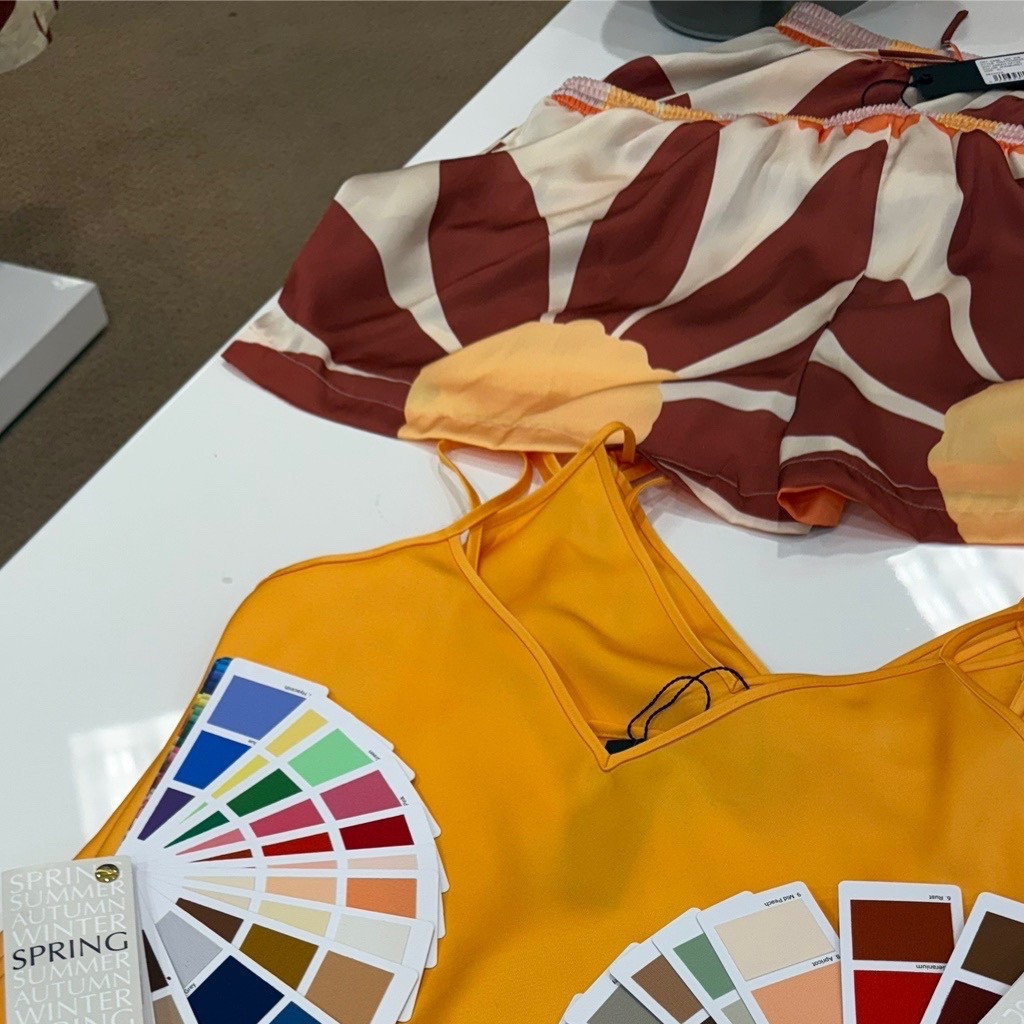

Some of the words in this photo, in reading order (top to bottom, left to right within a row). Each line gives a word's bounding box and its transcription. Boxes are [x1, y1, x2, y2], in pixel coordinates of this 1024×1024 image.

[9, 861, 123, 893] SPRIN
[10, 879, 124, 911] SUMMER
[764, 898, 783, 906] Peach
[11, 896, 125, 928] AUTUMN
[12, 912, 126, 946] WINTER
[12, 930, 128, 970] SPRING
[812, 956, 833, 966] Apricot
[13, 951, 130, 989] SUMMER
[13, 970, 131, 1007] AUTUMN
